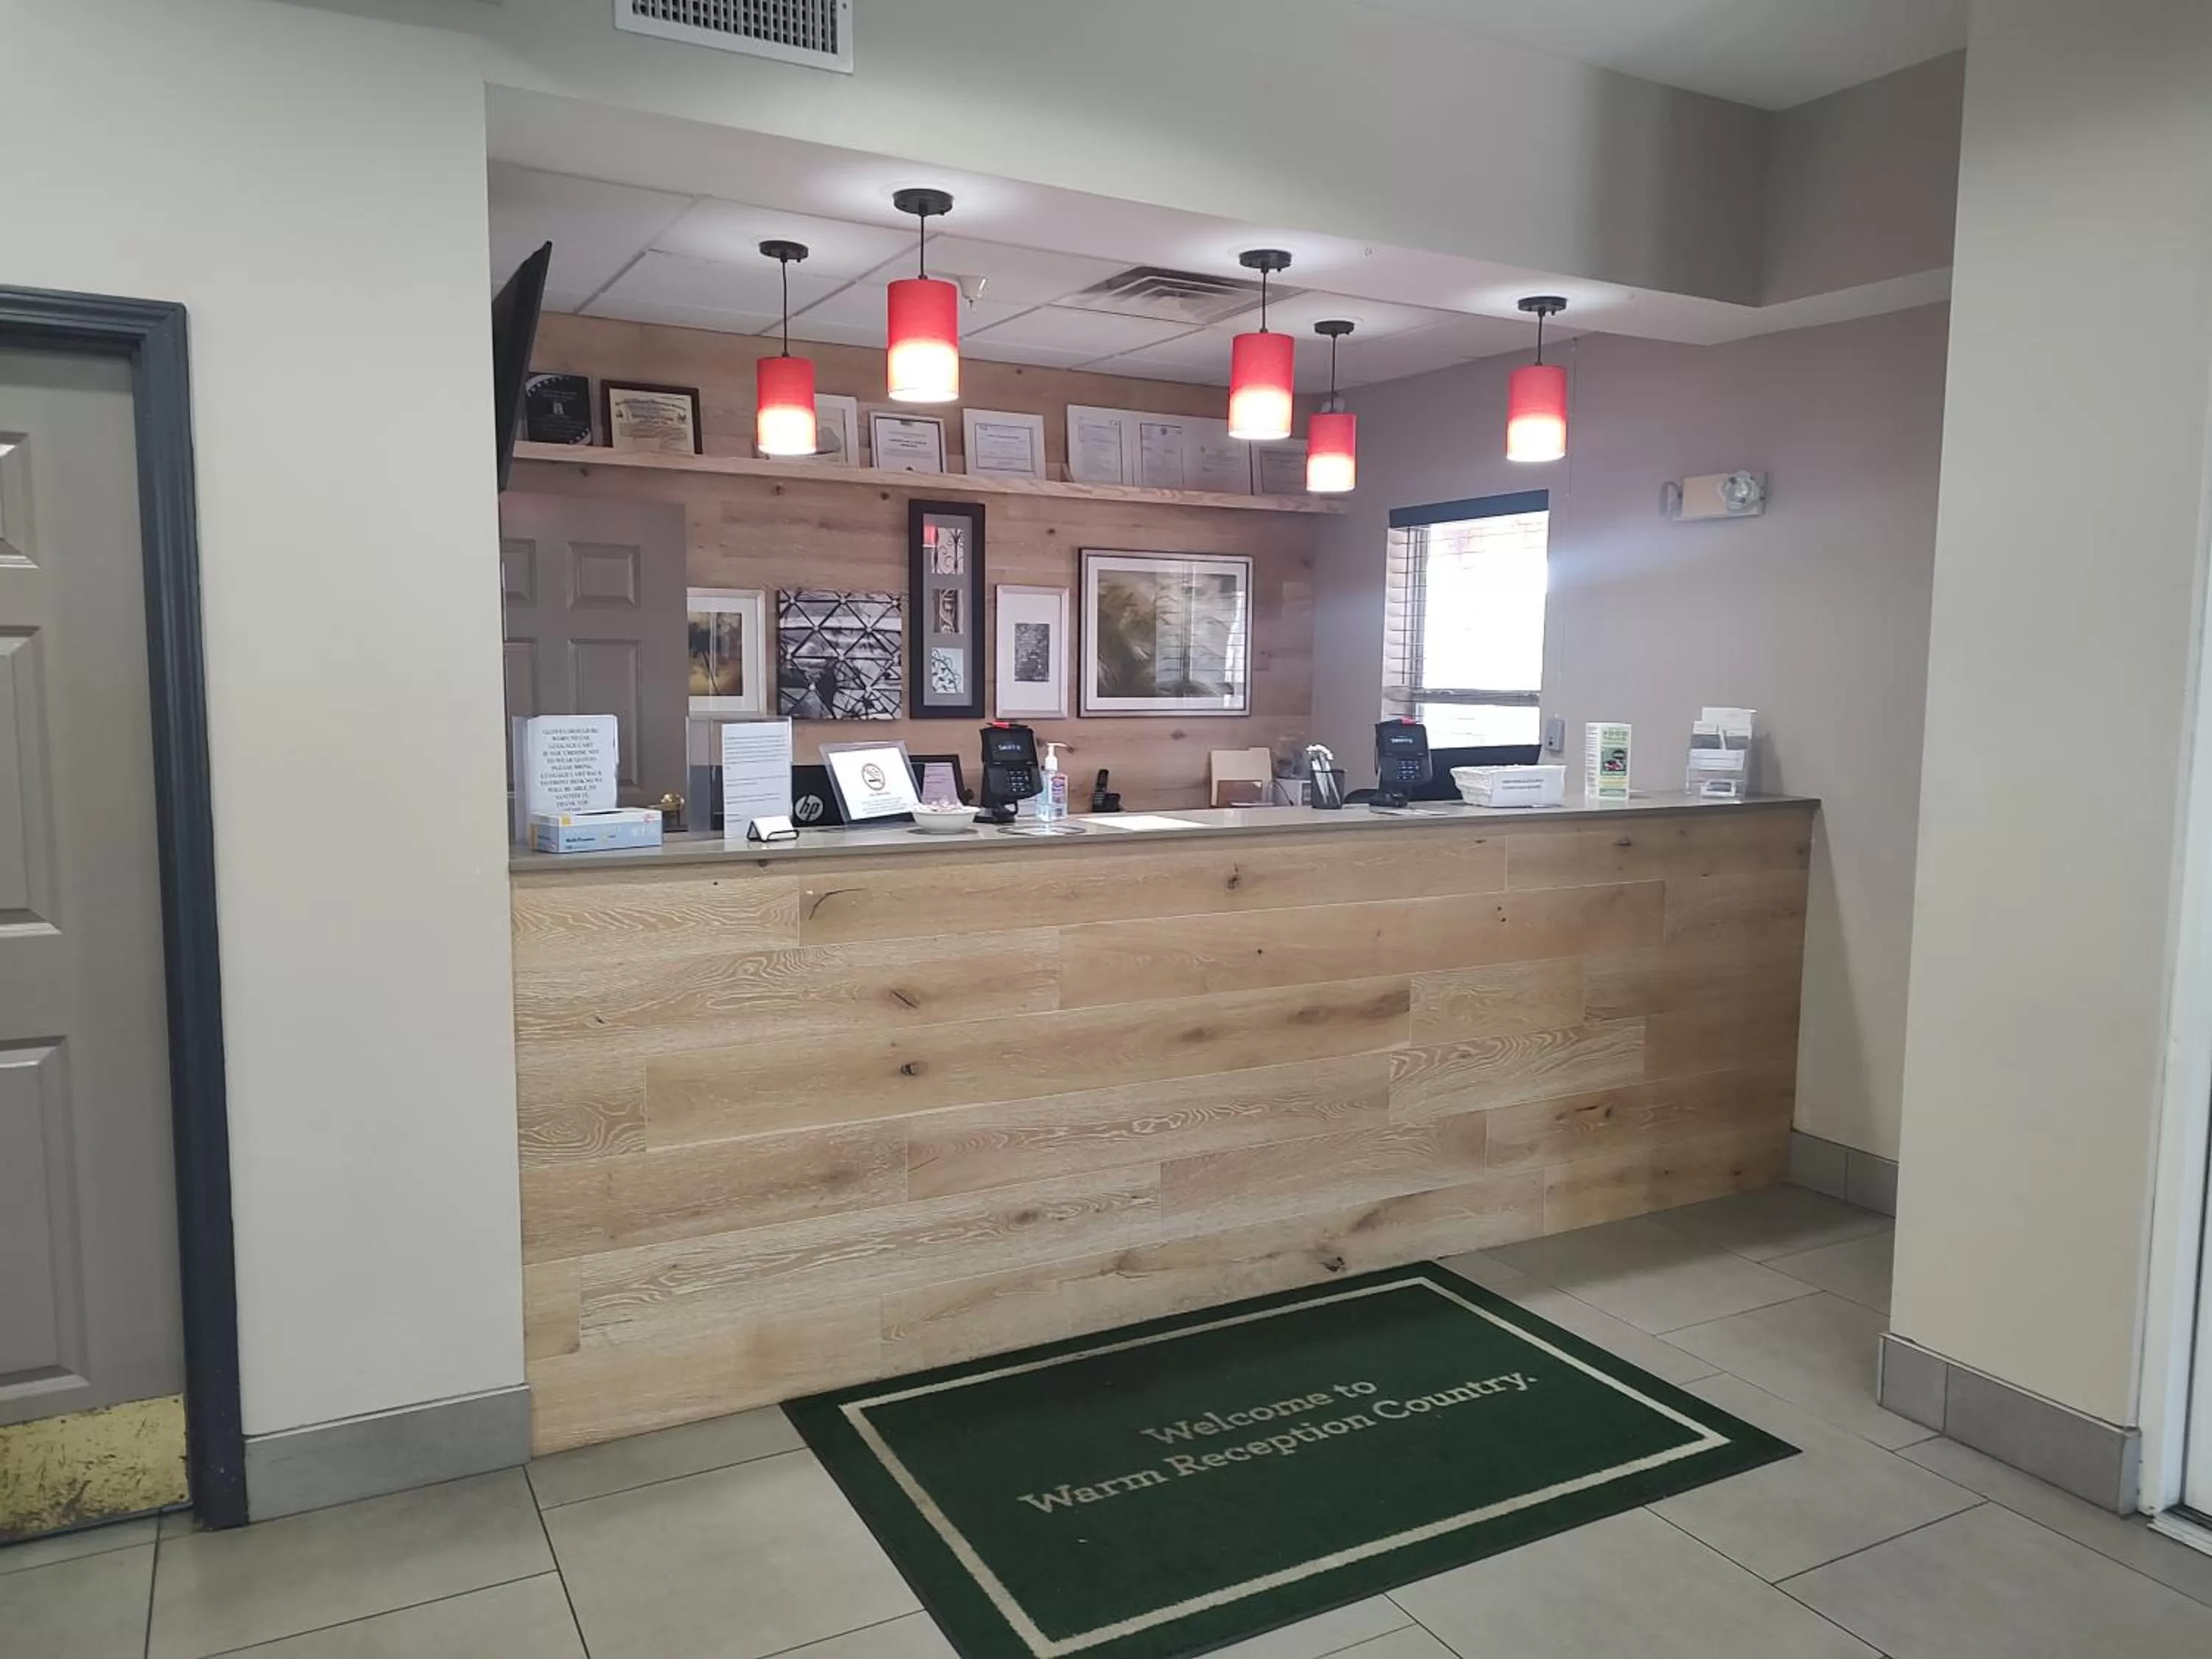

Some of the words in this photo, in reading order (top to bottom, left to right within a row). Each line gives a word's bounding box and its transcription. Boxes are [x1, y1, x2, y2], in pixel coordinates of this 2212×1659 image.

[797, 795, 821, 821] hp
[1018, 1470, 1171, 1514] Warm
[1162, 1413, 1377, 1477] Reception
[1371, 1371, 1538, 1419] Country.
[1140, 1392, 1333, 1444] Welcome
[1333, 1380, 1377, 1398] to
